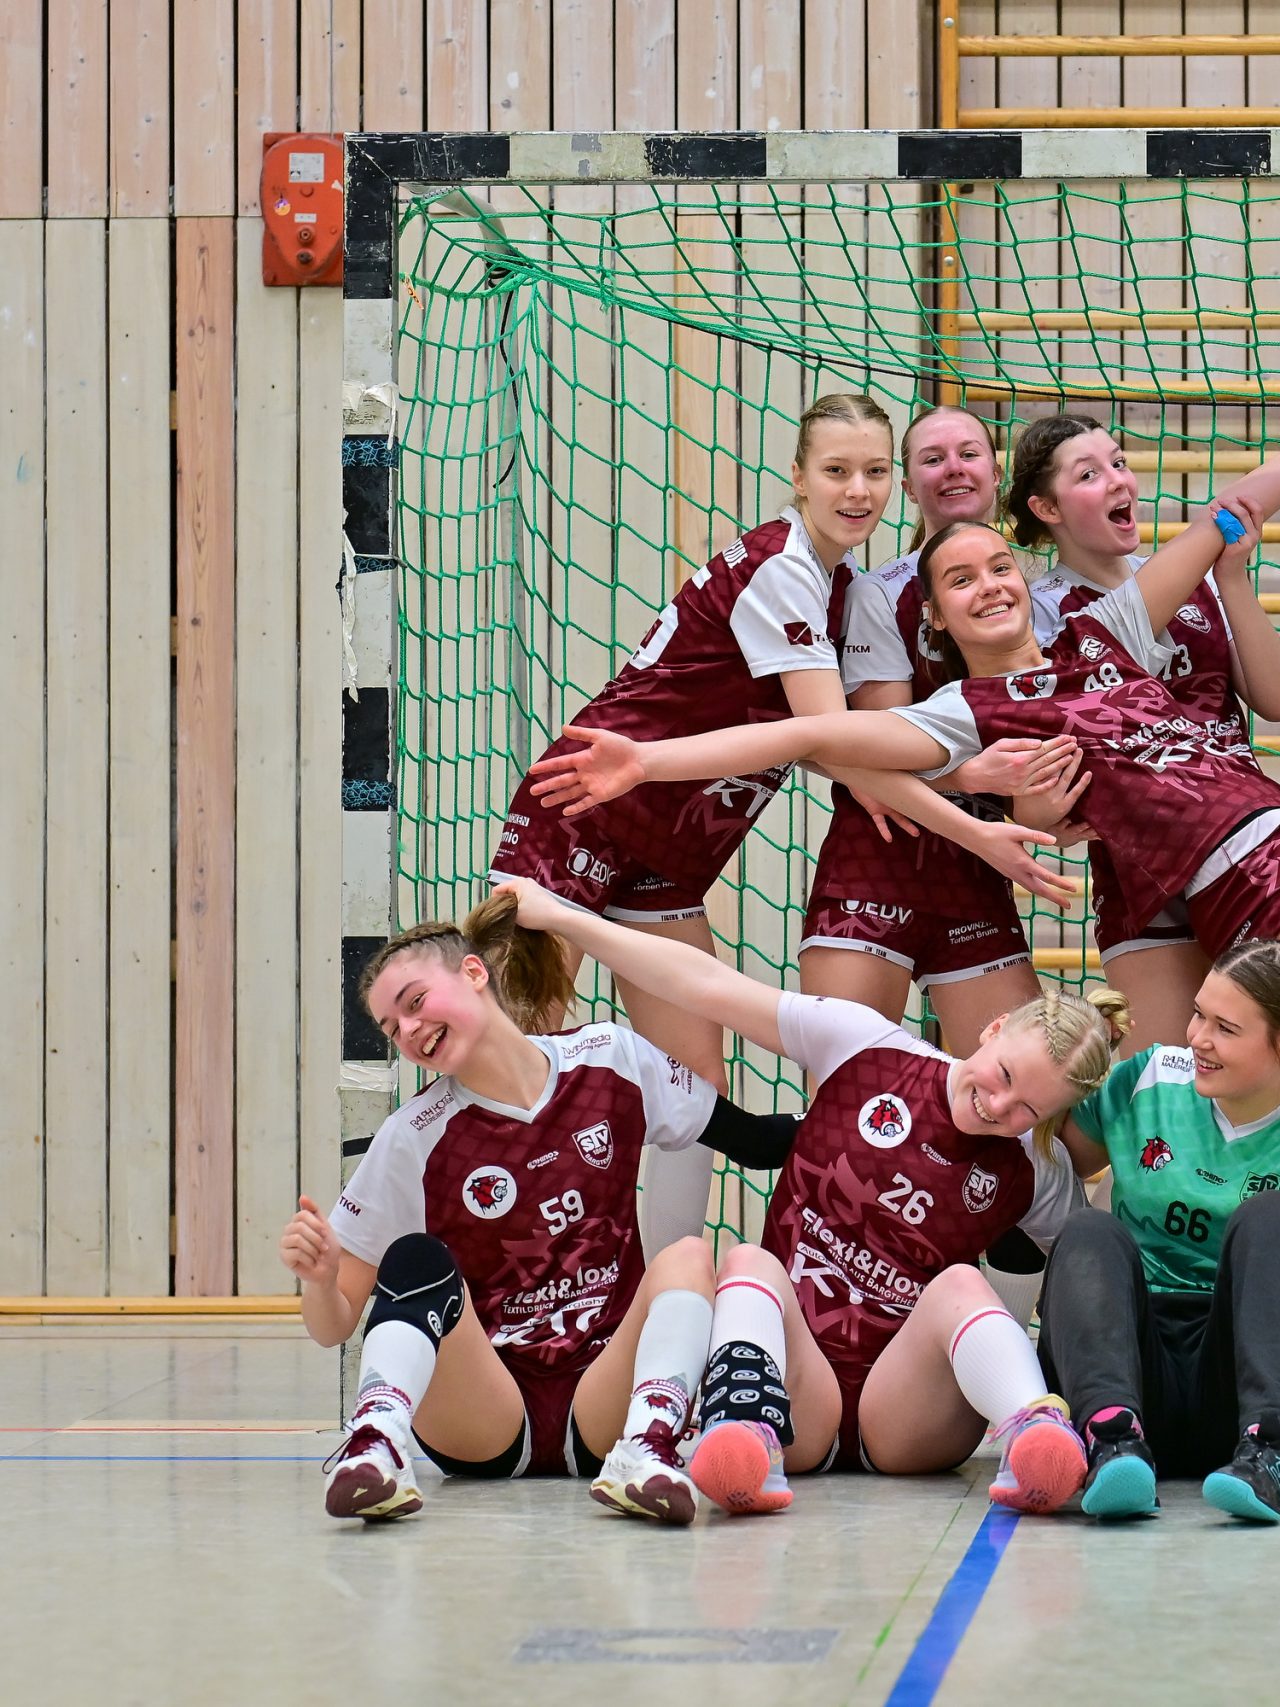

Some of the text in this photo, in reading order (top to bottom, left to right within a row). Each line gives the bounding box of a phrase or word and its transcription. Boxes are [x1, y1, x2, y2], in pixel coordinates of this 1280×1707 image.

[844, 645, 871, 654] TKM
[1084, 662, 1124, 693] 48
[950, 926, 999, 945] Torben Bruns
[409, 1107, 434, 1129] RALPH
[577, 1123, 609, 1153] STV
[968, 1167, 997, 1196] STV
[339, 1195, 362, 1217] TKM
[538, 1189, 585, 1236] 59
[877, 1172, 935, 1225] 26
[1164, 1200, 1212, 1243] 66
[866, 1277, 917, 1307] BARGTEHEI
[503, 1302, 555, 1315] TEXTILDRUCK
